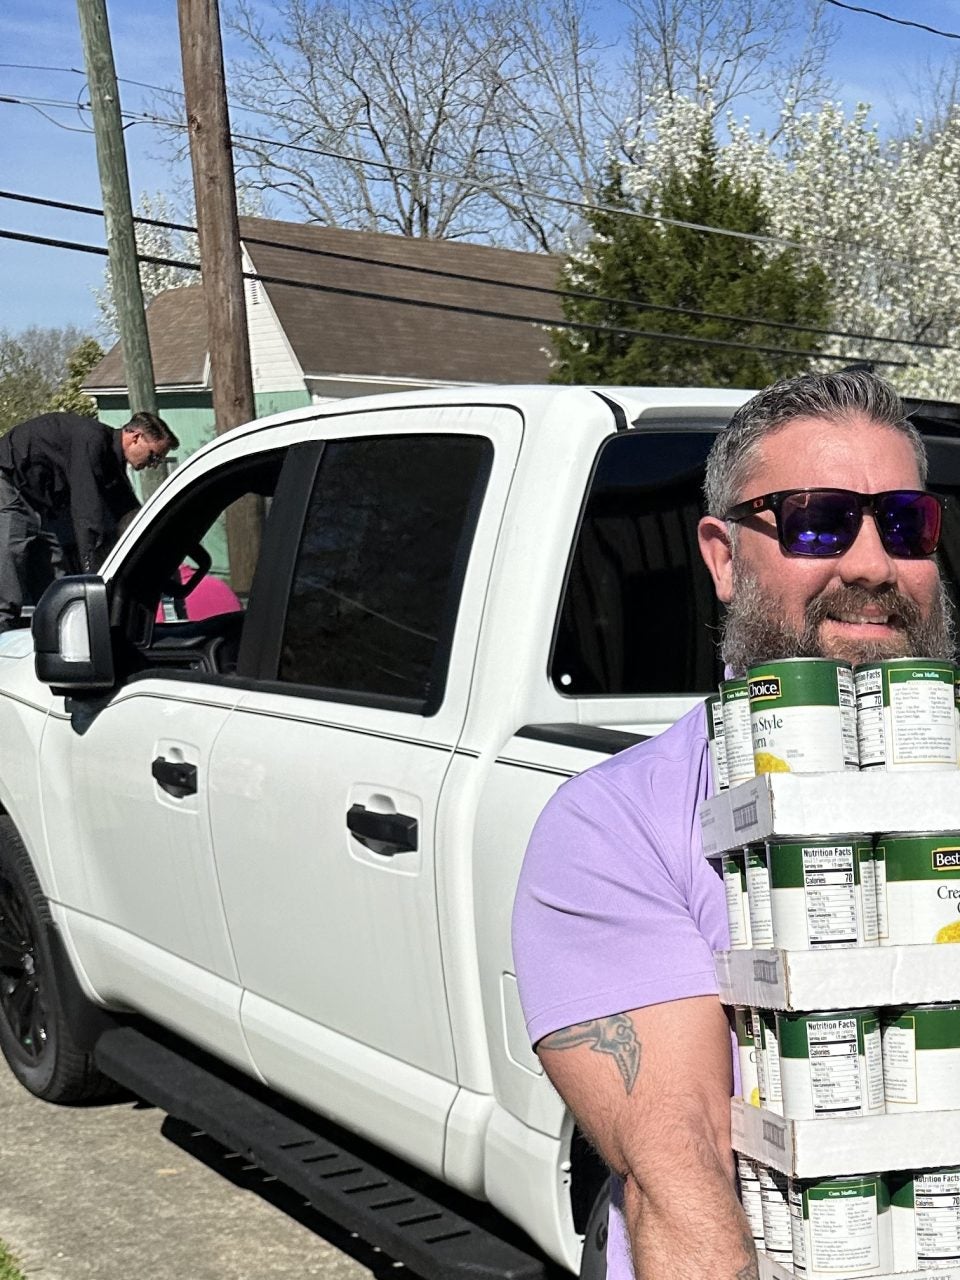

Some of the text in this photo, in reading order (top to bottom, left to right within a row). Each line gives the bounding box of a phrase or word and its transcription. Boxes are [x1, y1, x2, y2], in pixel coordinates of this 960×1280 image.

[866, 670, 881, 681] Facts
[874, 695, 882, 705] 70
[759, 714, 783, 735] Style
[803, 847, 852, 858] Nutrition Facts
[936, 852, 960, 866] Best
[805, 872, 853, 885] Calories 70
[807, 1020, 856, 1031] Nutrition Facts
[848, 1043, 857, 1053] 70
[914, 1174, 960, 1183] Nutrition Facts
[915, 1196, 960, 1207] Calories 70
